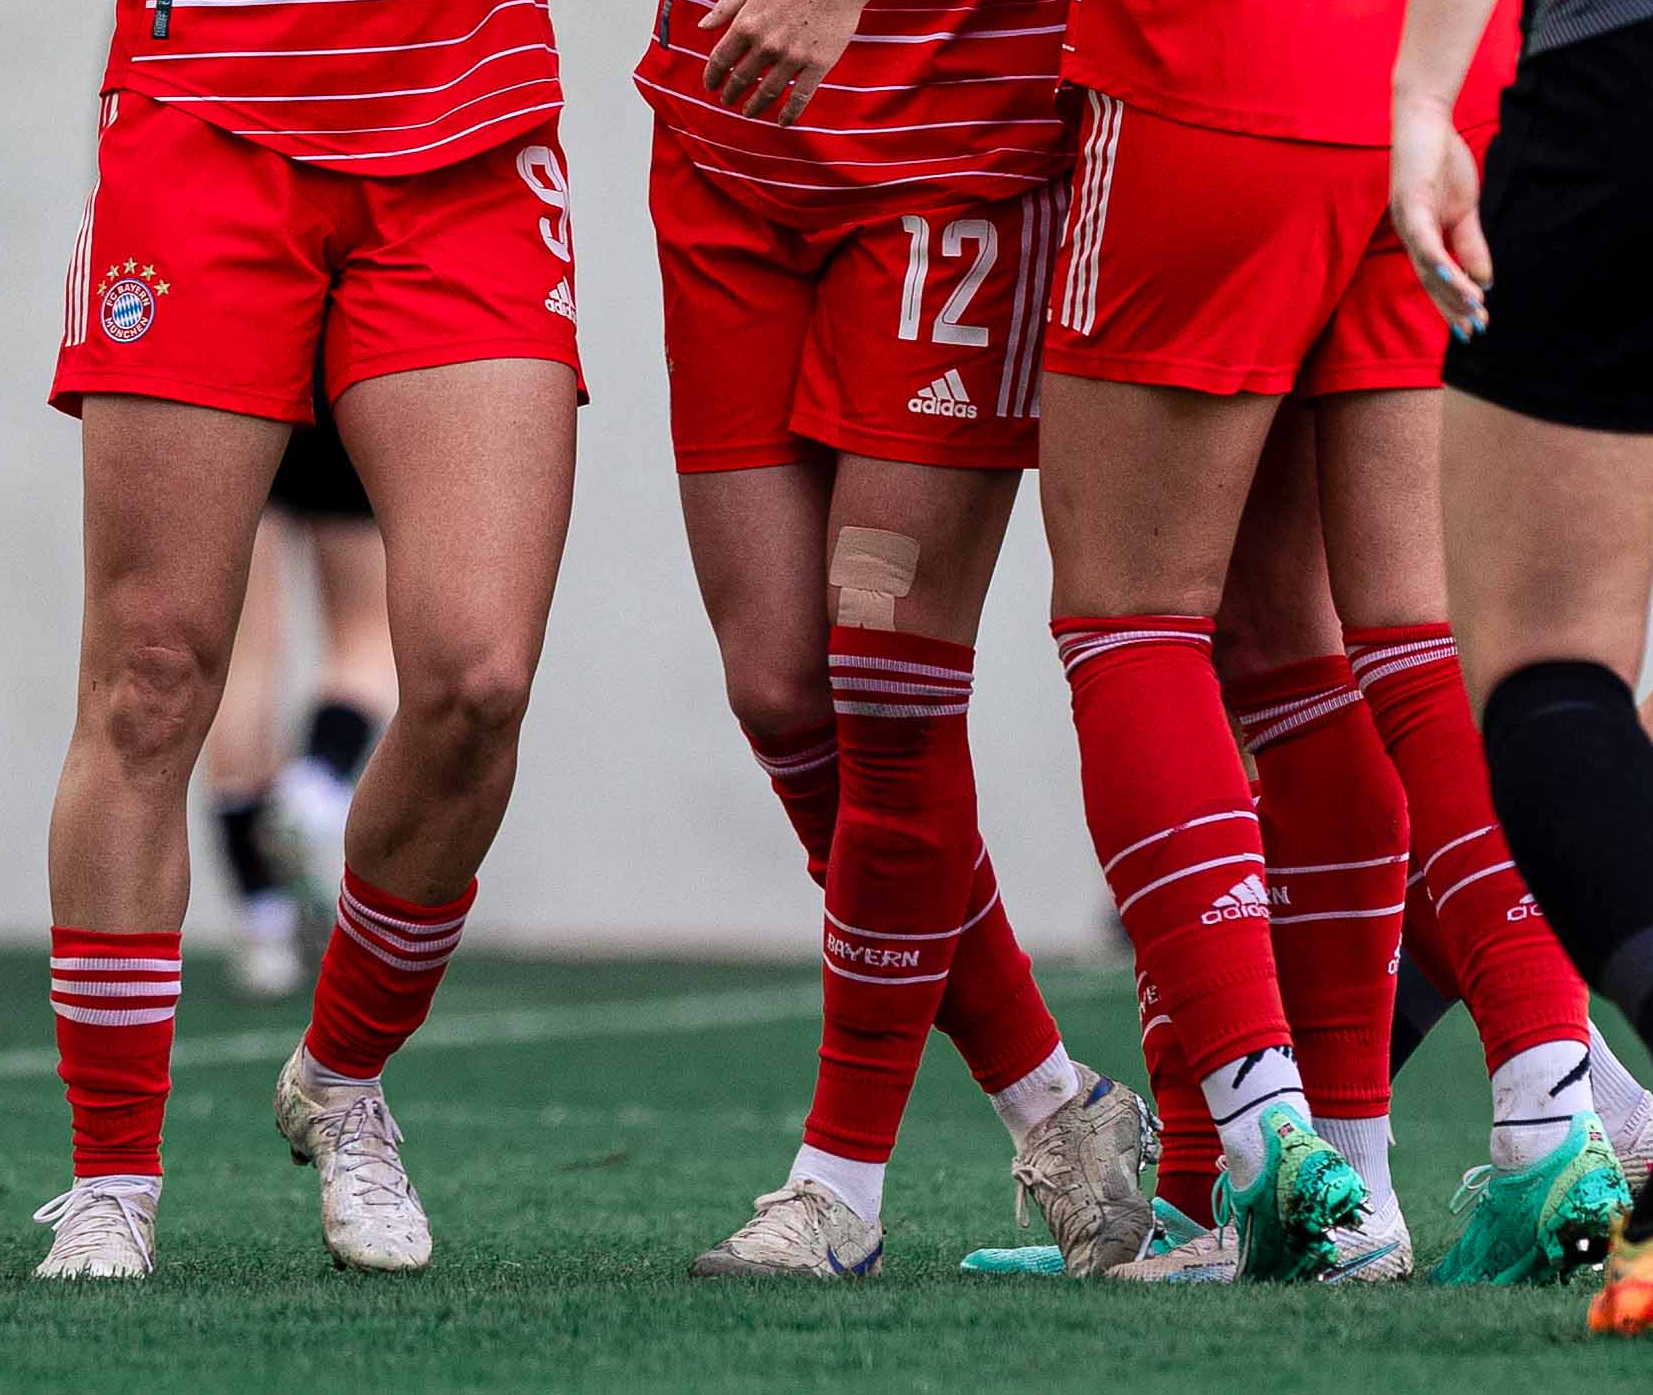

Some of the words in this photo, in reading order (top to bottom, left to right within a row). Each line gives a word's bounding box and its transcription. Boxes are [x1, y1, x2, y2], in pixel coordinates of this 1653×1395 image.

[515, 145, 572, 263] 9
[117, 283, 151, 306] BAYERN
[898, 214, 1000, 348] 12
[907, 395, 979, 420] adidas
[827, 931, 921, 968] BAYERN
